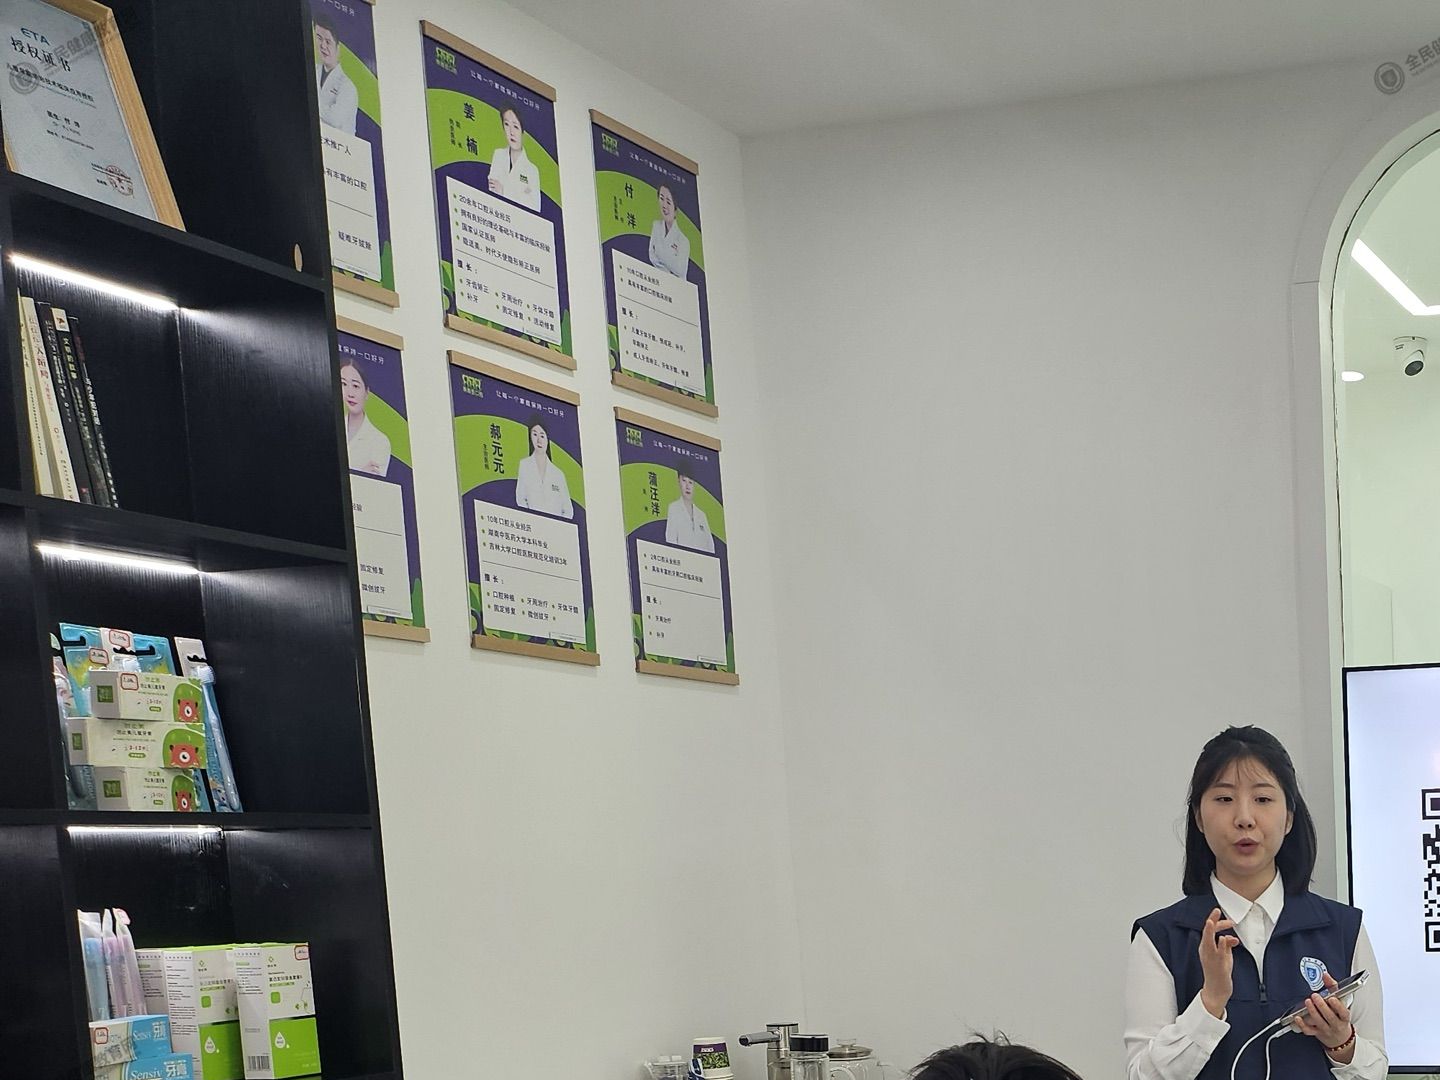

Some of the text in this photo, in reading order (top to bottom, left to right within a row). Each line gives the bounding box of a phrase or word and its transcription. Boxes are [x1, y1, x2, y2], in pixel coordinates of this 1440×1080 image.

[323, 167, 368, 192] 有丰富的口腔
